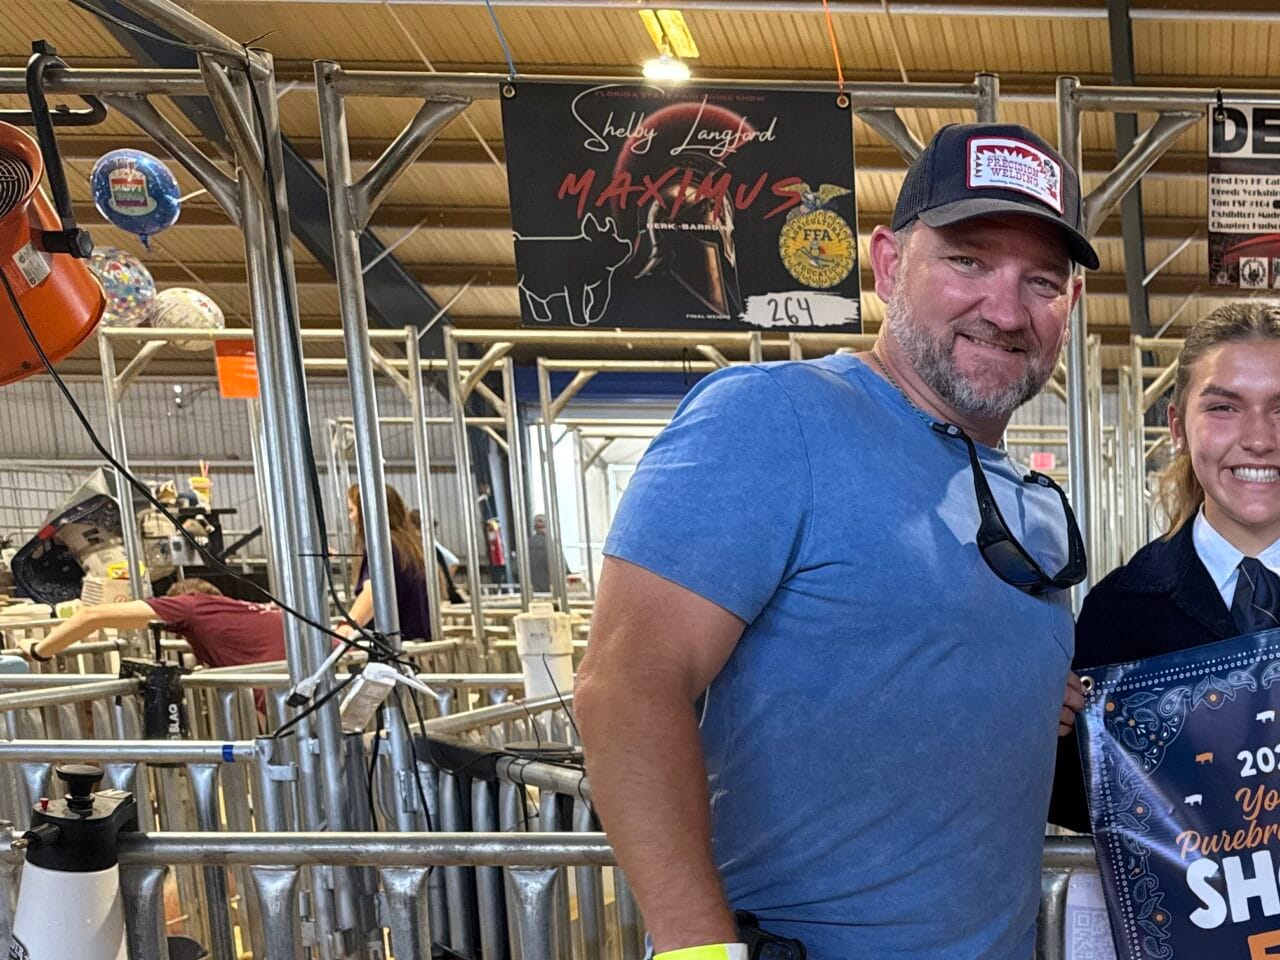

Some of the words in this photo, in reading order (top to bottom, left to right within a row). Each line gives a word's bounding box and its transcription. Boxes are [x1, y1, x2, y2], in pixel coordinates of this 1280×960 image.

[571, 84, 658, 154] Shelby
[670, 94, 778, 156] Langford
[986, 157, 1040, 179] PRECISION
[990, 167, 1040, 187] WELDING
[557, 167, 805, 219] MAXIMUS
[803, 229, 832, 241] FFA
[767, 297, 814, 326] 264
